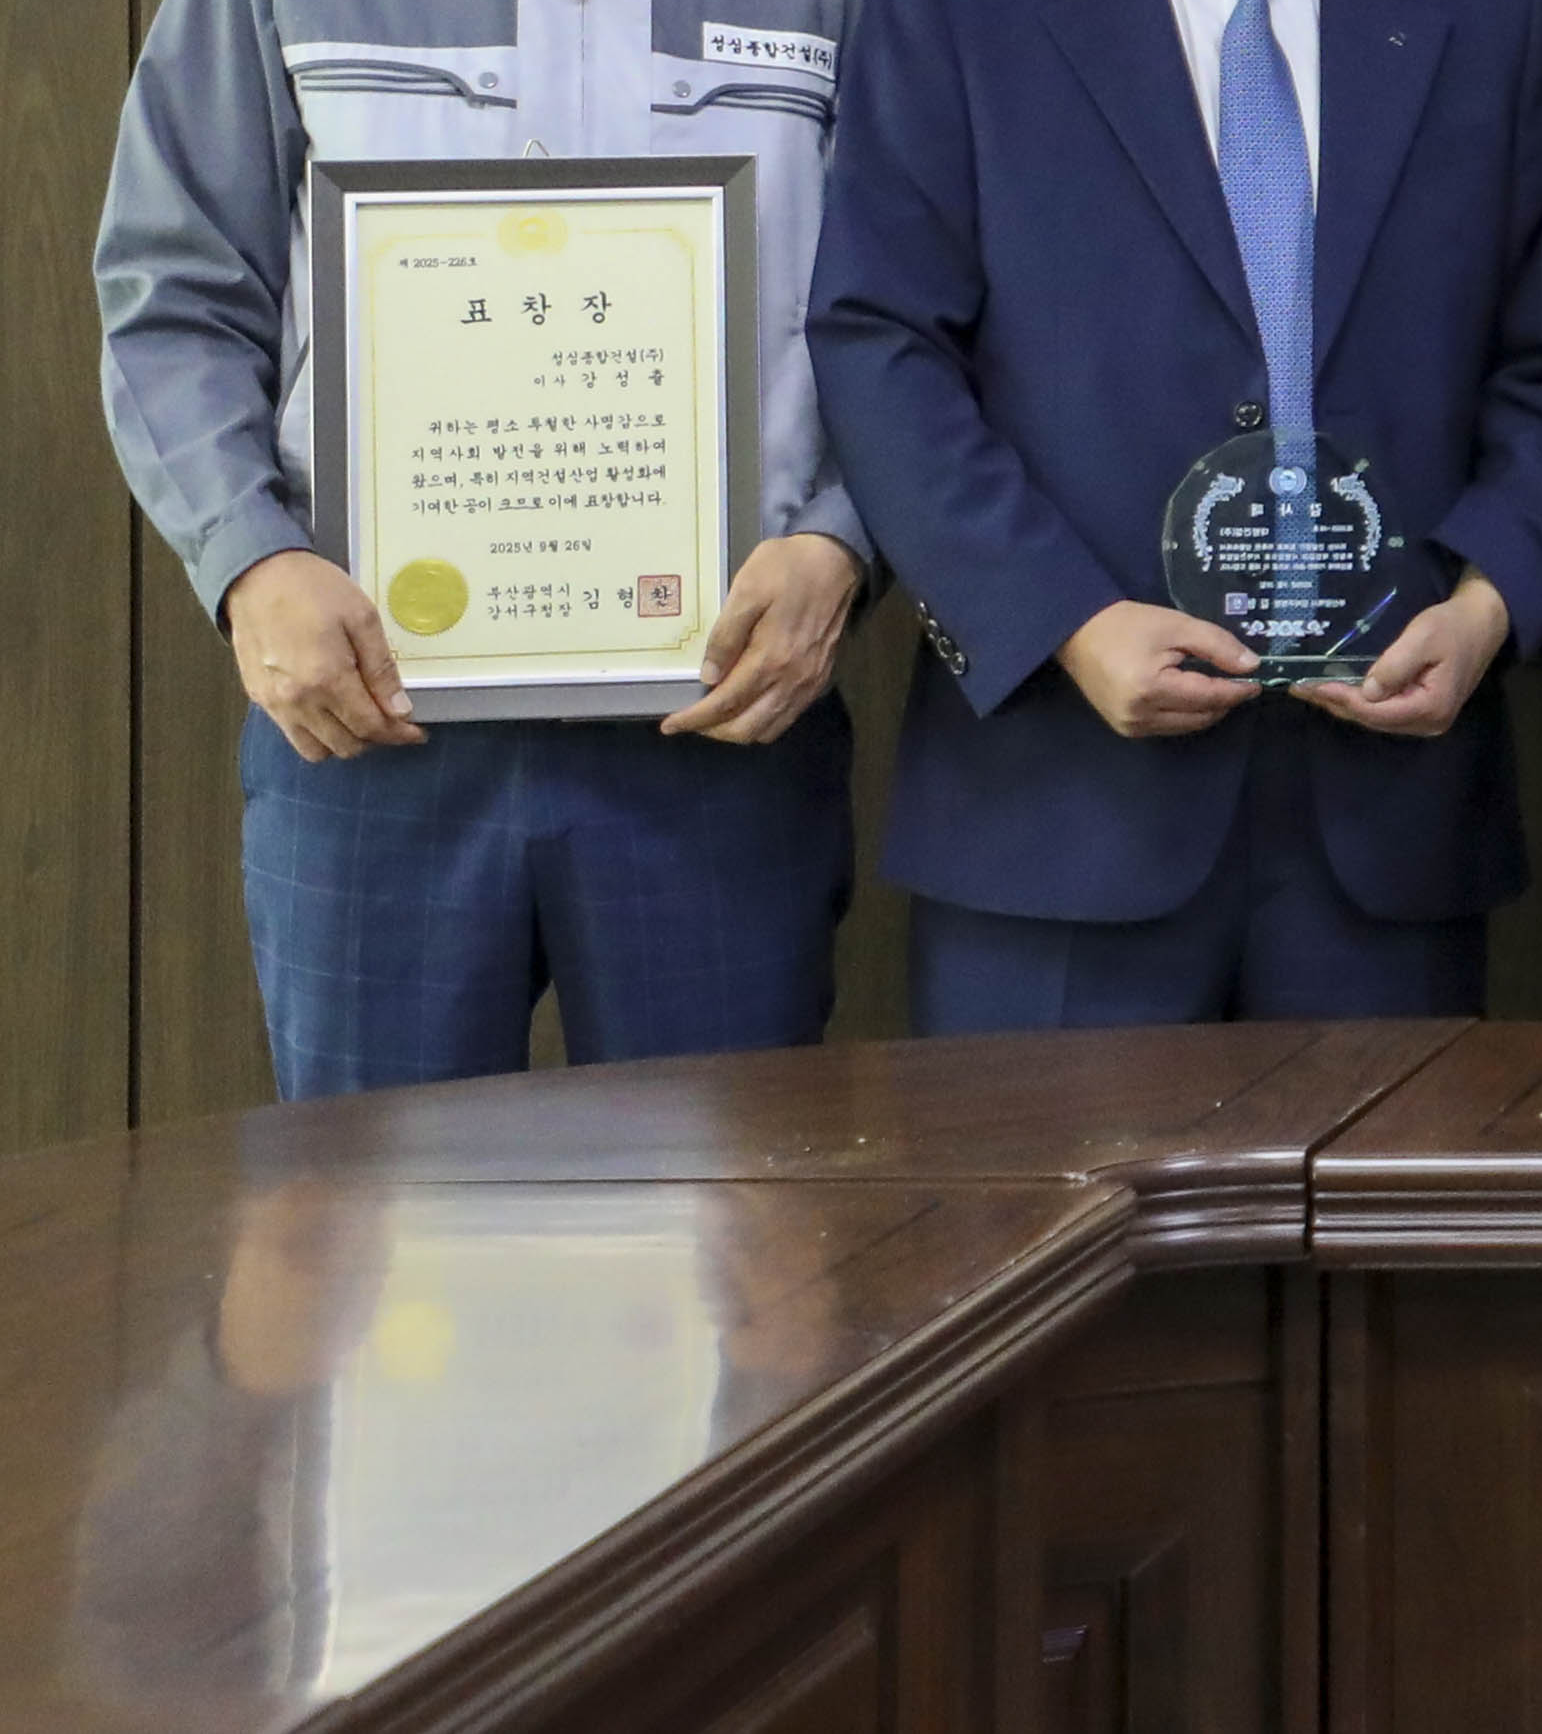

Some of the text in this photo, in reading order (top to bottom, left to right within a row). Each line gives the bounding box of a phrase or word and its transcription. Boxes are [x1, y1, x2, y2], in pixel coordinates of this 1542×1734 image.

[712, 35, 833, 70] 성심종합건설(주)
[552, 348, 663, 366] 성심종합건설(주)
[582, 371, 597, 389] 강
[616, 370, 628, 387] 성
[429, 414, 666, 435] 귀하는 평소 투철한 사명감으로
[412, 438, 665, 461] 지역사회 발전을 위해 노력하여
[412, 465, 665, 489] 왔으며, 특히 지역건설산업 활성화에
[413, 491, 667, 514] 기여한 공이 크므로 이에 표창합니다.
[490, 539, 591, 554] 2025년 9월 26일
[487, 583, 569, 600] 부산광역시
[488, 602, 571, 620] 강서구청장
